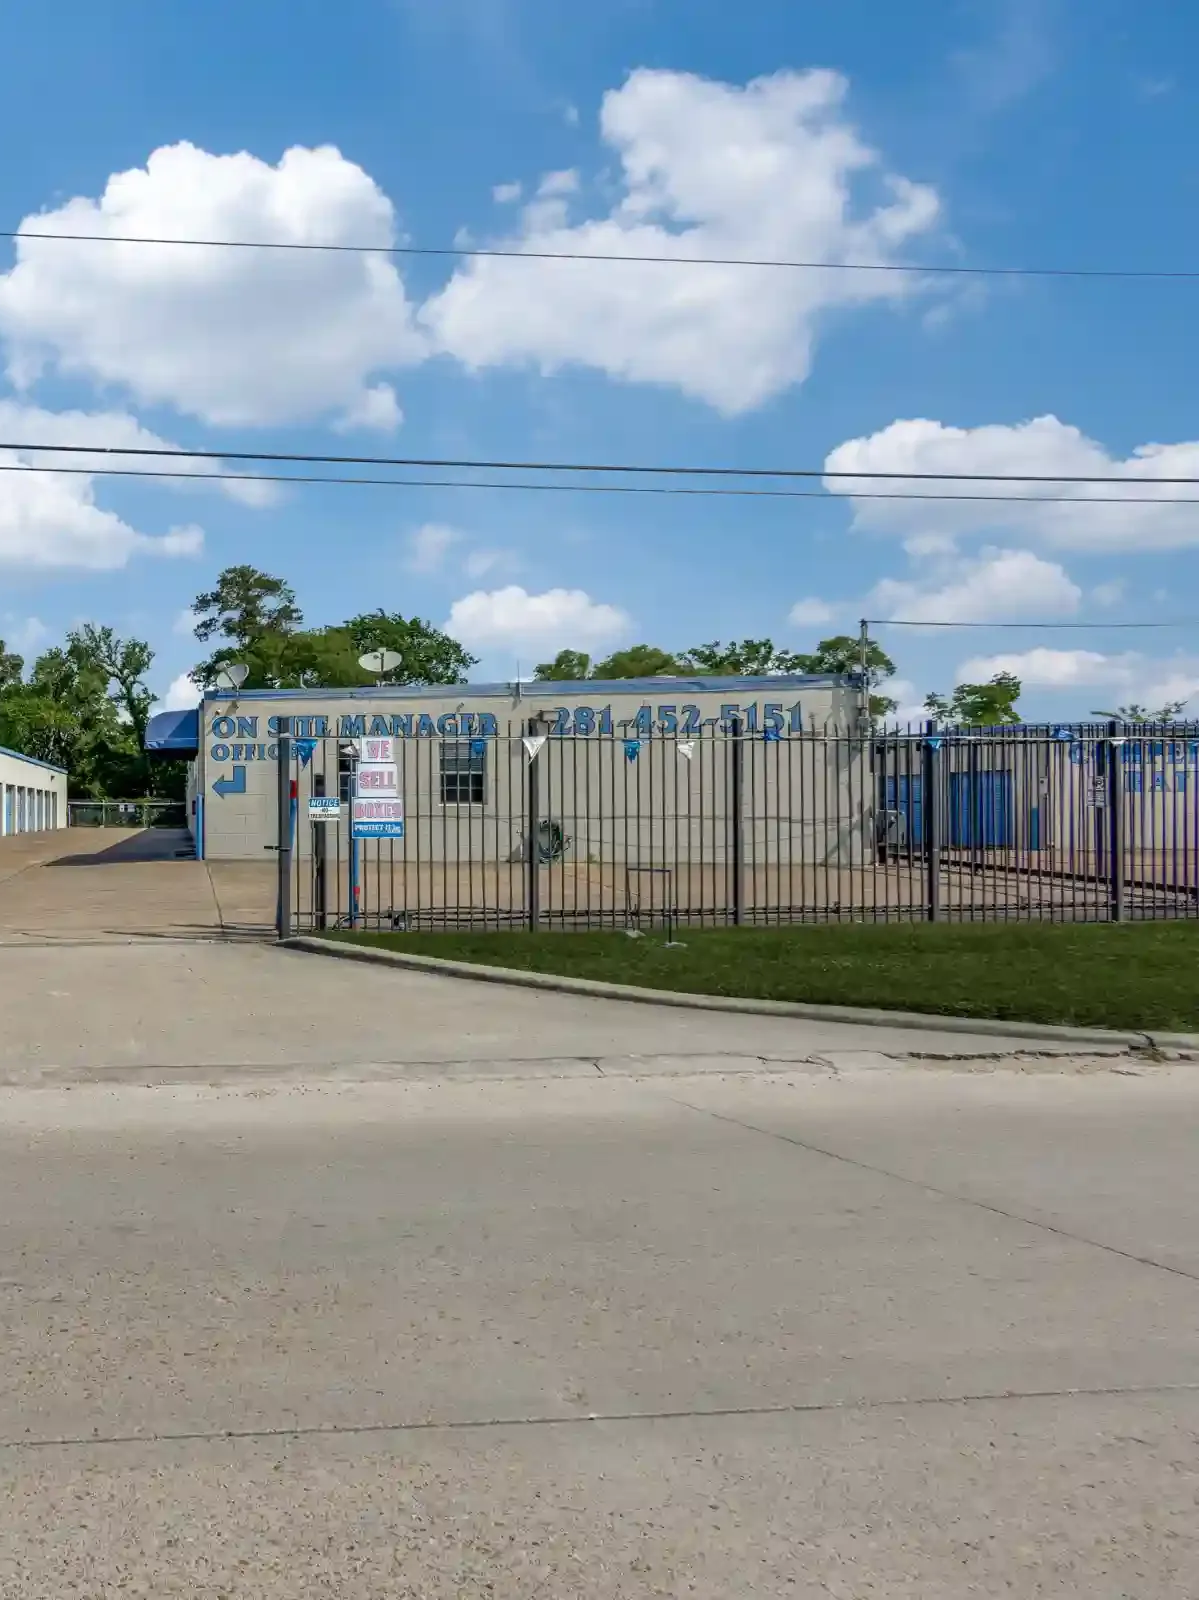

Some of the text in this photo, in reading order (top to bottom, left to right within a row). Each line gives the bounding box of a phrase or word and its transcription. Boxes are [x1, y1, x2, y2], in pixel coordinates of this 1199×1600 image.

[211, 712, 498, 739] ON SITE MANAGER
[550, 700, 802, 736] 281-452-5151
[366, 740, 390, 759] WE
[359, 770, 397, 790] SELL
[310, 799, 339, 807] NOTICE
[354, 802, 402, 819] BOXES
